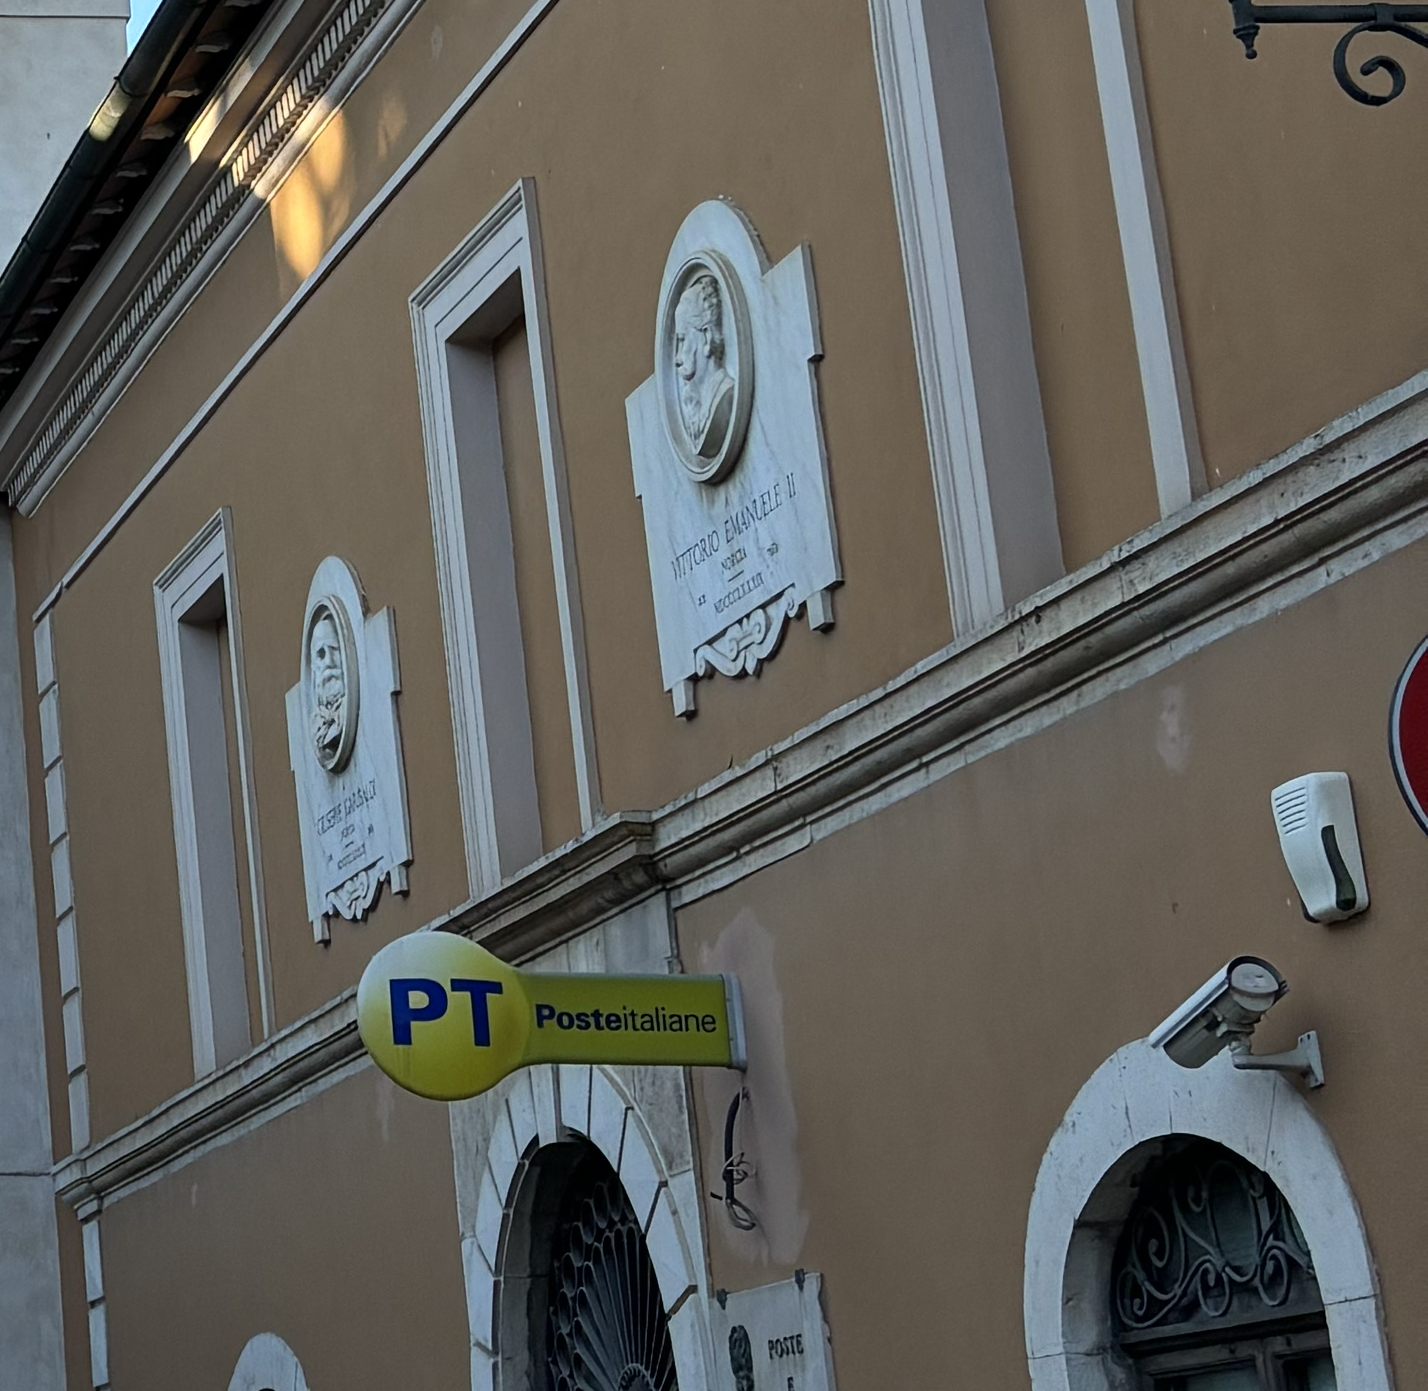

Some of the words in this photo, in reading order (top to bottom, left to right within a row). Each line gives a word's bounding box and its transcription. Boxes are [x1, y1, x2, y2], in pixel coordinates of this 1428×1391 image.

[671, 530, 720, 581] VITTORIO
[724, 483, 783, 545] EMANUELE
[786, 472, 797, 499] II
[389, 977, 503, 1047] PT
[767, 1334, 804, 1360] POSTE
